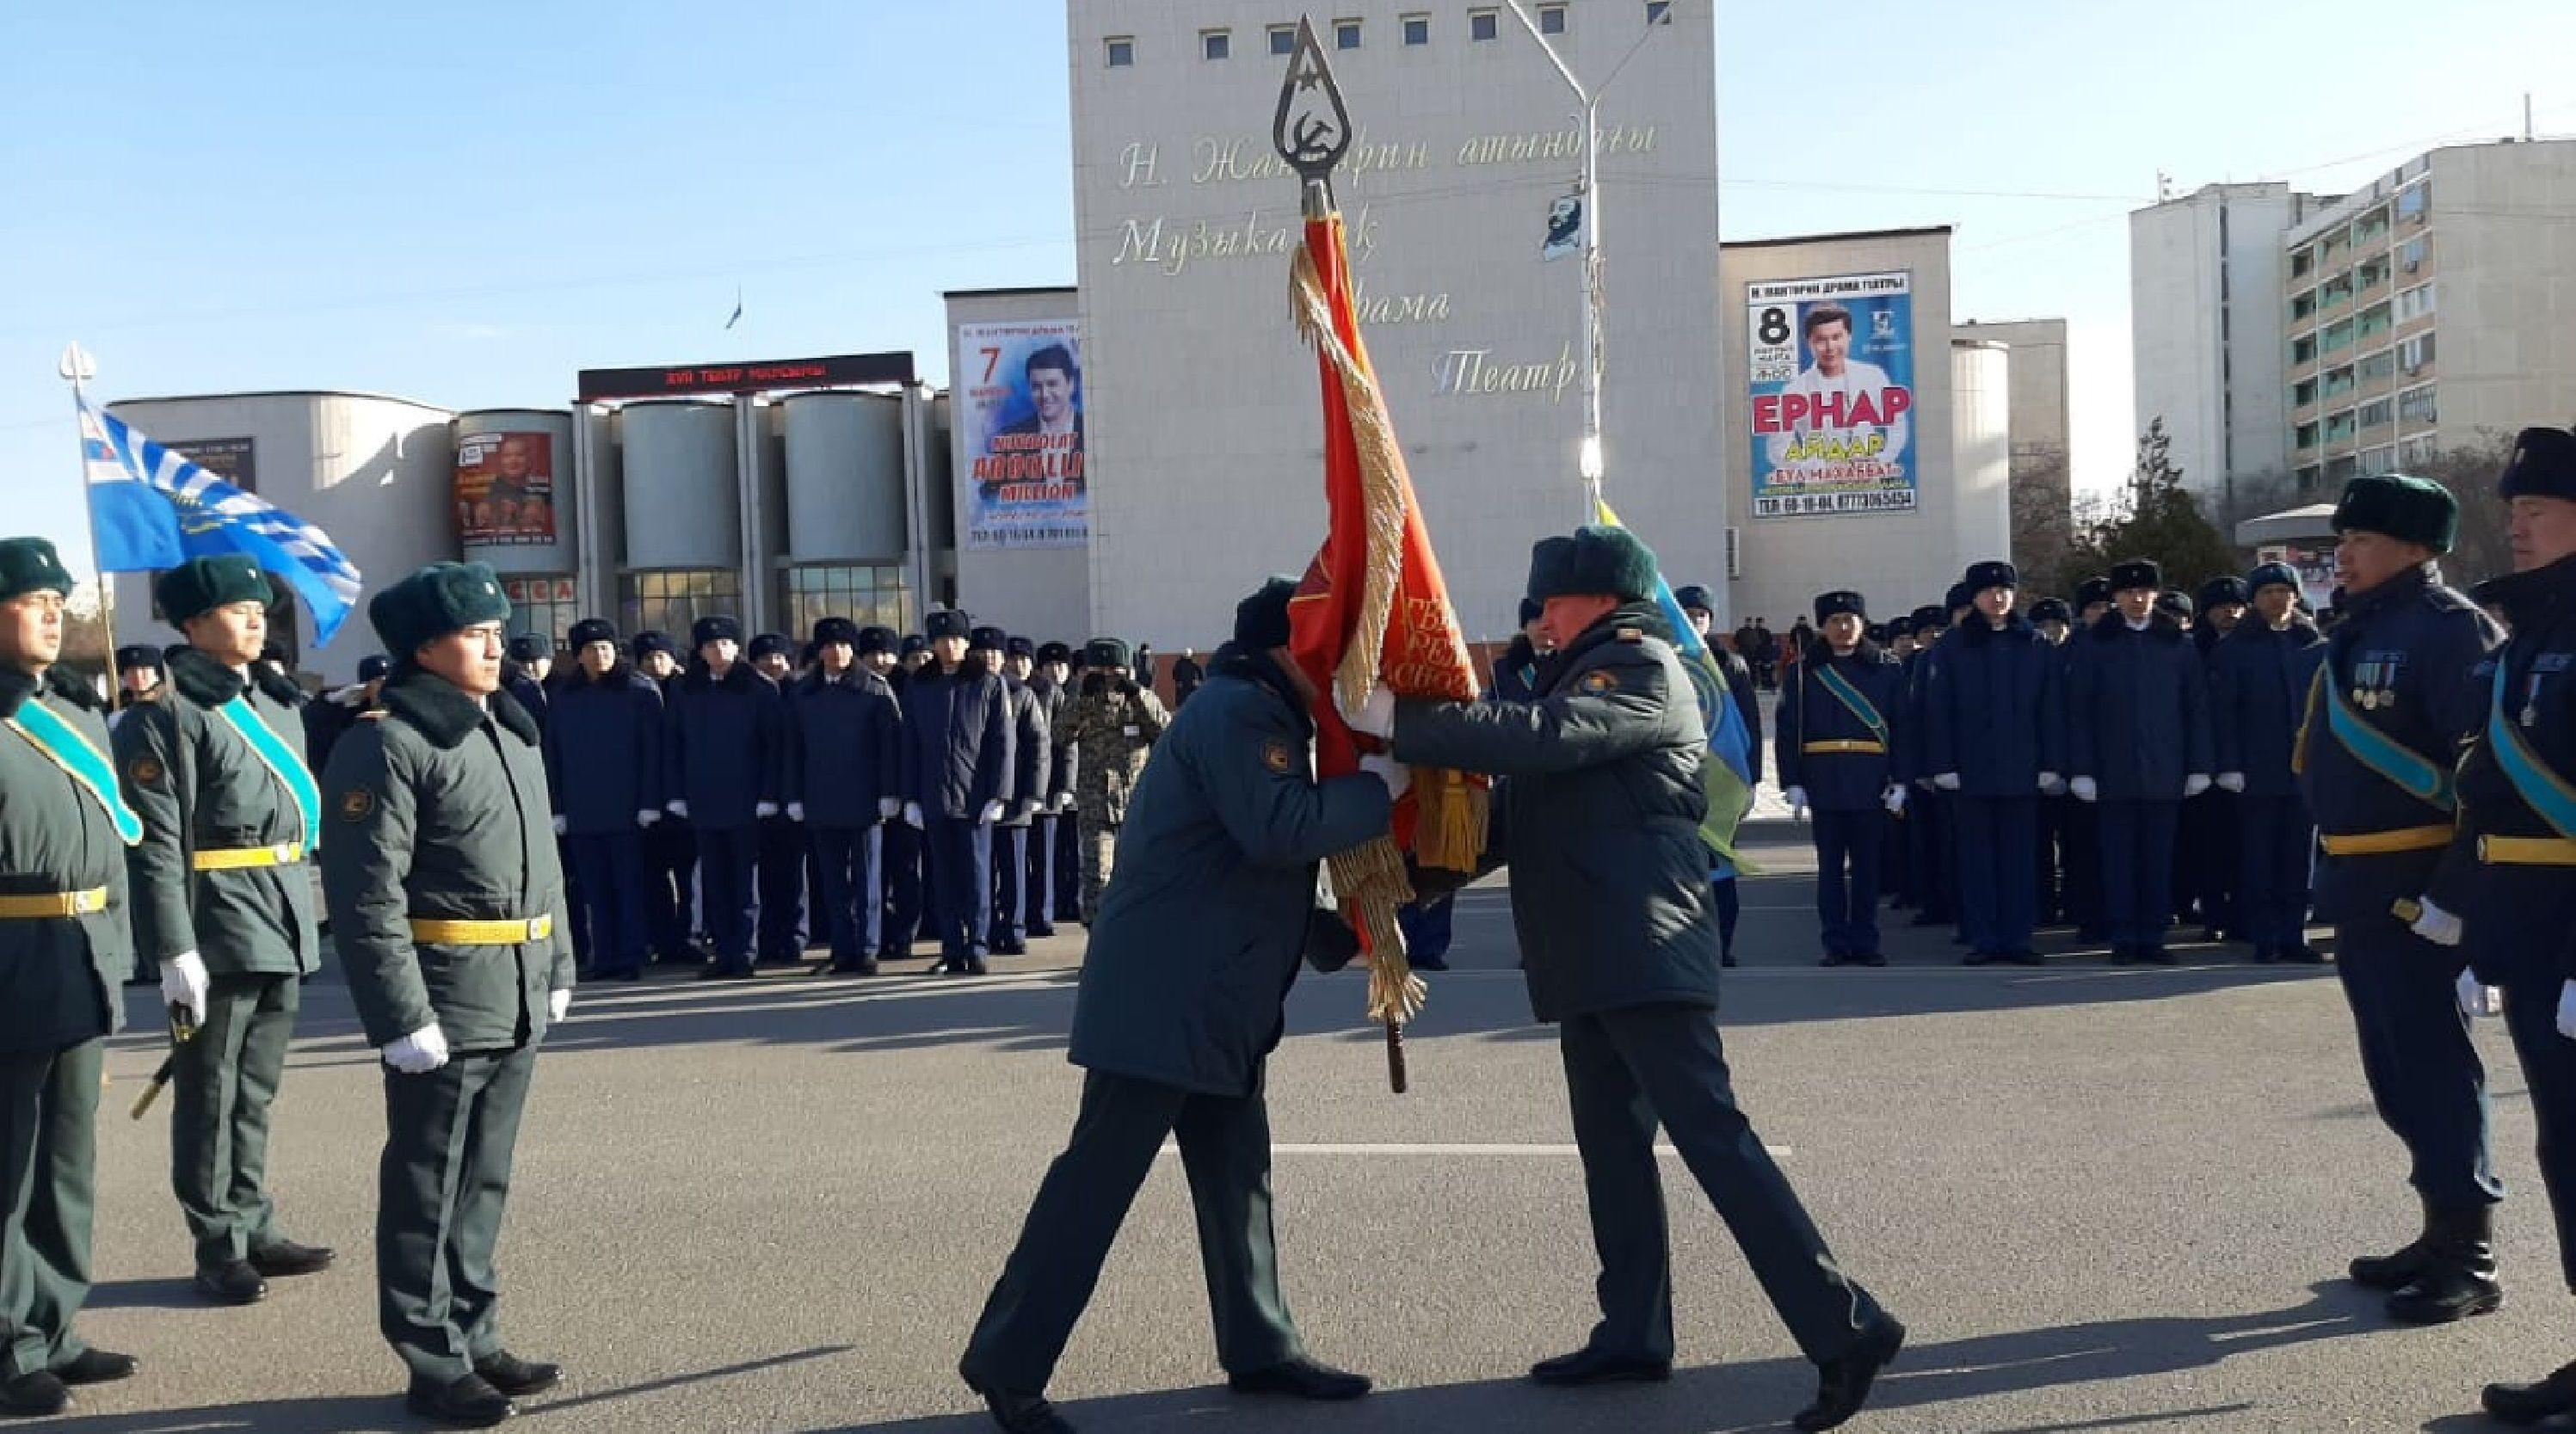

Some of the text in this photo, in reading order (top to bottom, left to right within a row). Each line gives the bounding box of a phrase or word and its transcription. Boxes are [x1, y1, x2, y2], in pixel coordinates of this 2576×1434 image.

[1191, 126, 1430, 187] Жанрин
[1112, 203, 1378, 277] Музыкақ
[1759, 307, 1790, 345] 8
[979, 348, 1000, 384] 7
[1431, 341, 1581, 405] Театр
[1753, 386, 1912, 434] ЕРНАР
[1785, 432, 1884, 461] АЙДАР
[1000, 482, 1075, 502] MILLION
